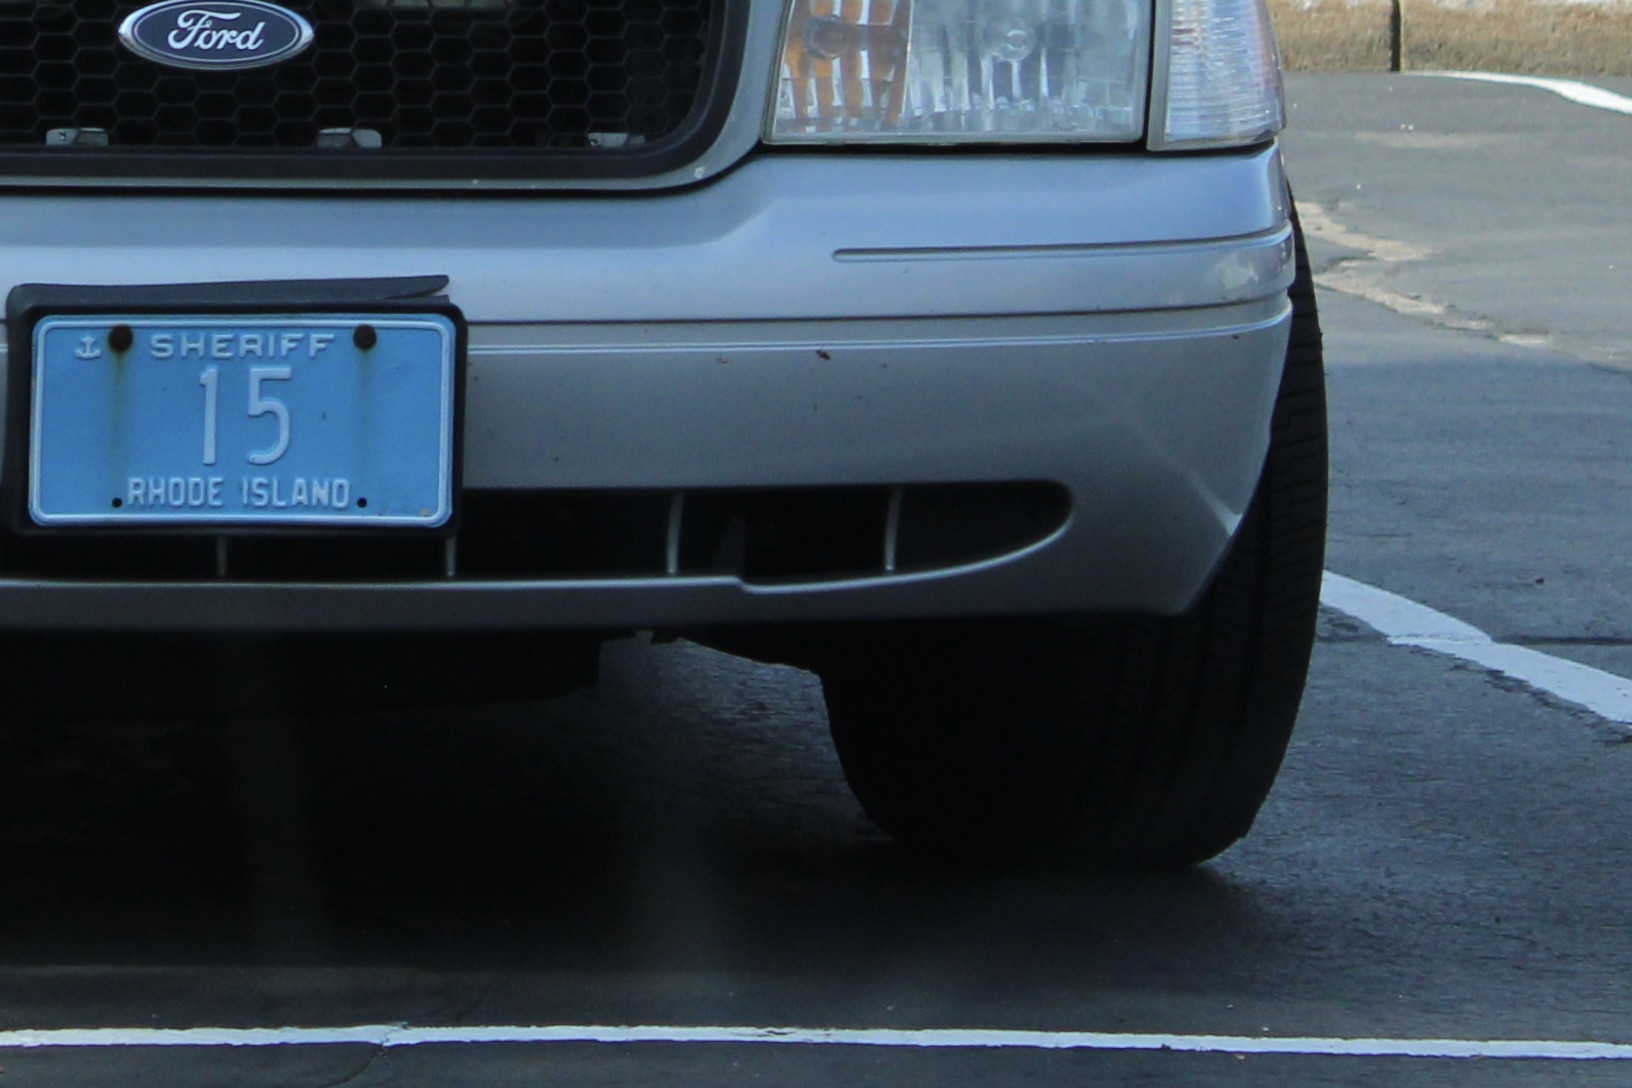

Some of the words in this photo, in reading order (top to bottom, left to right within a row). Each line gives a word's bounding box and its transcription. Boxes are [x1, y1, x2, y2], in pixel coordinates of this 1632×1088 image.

[167, 9, 266, 50] Ford
[149, 333, 336, 360] SHERIFF
[198, 363, 293, 466] 15
[126, 476, 225, 510] RHODE
[240, 475, 351, 510] ISLAND
